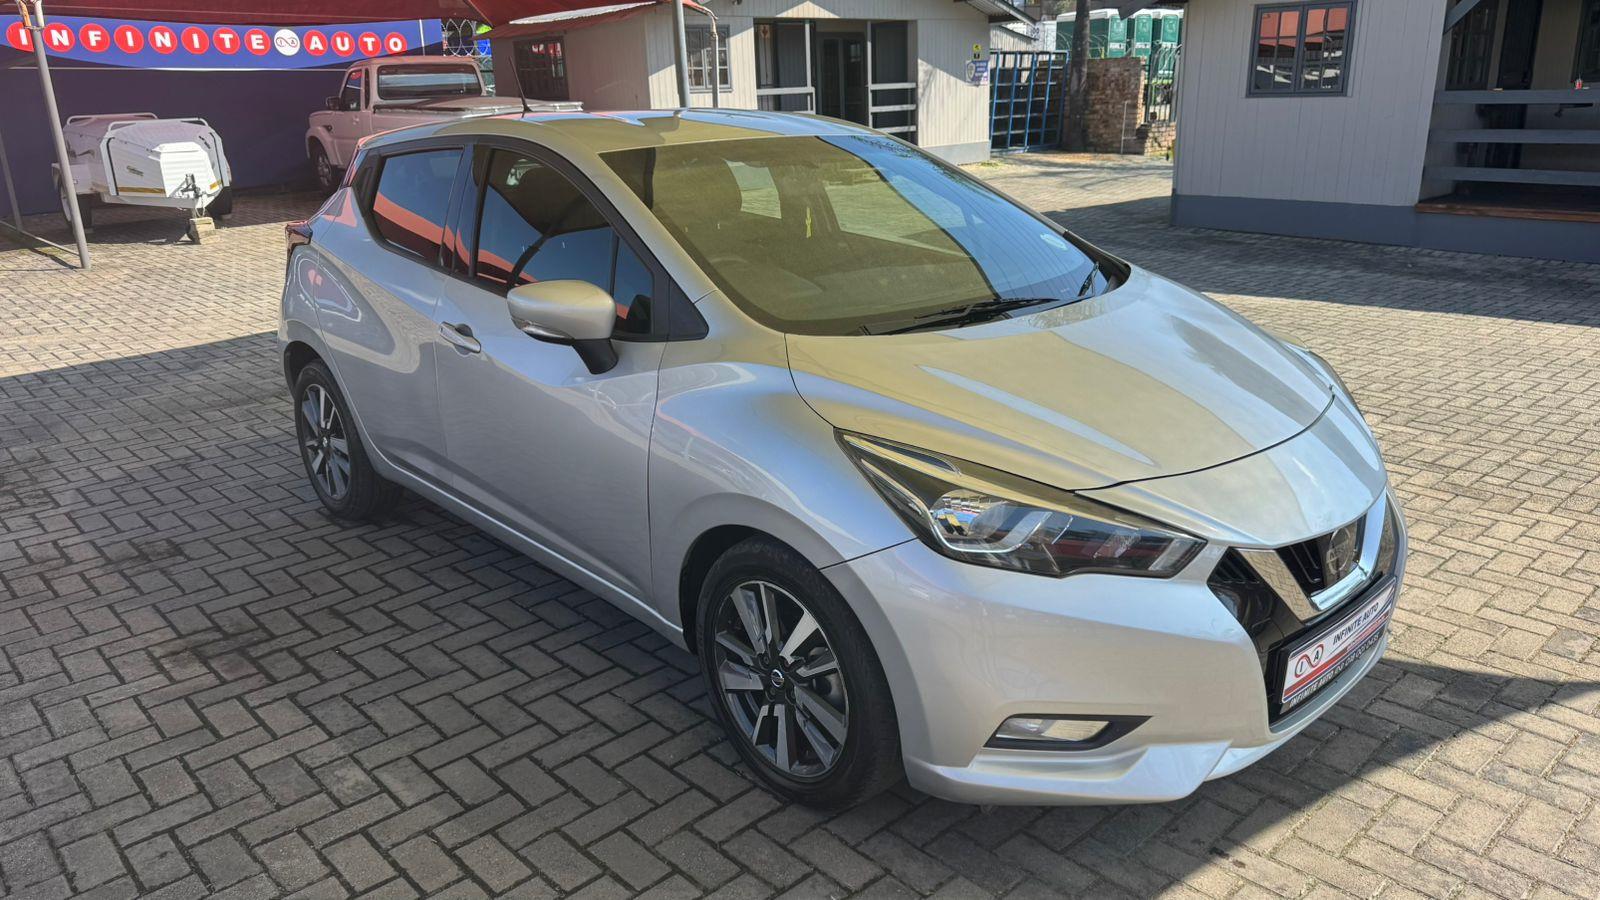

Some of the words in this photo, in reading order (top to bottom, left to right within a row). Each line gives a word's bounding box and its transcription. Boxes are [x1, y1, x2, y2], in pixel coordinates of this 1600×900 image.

[19, 28, 265, 50] INFINITE
[309, 36, 402, 52] AUTO
[1333, 616, 1361, 645] INFINITE
[1362, 602, 1379, 621] AUTO
[1290, 682, 1319, 708] INFINITE
